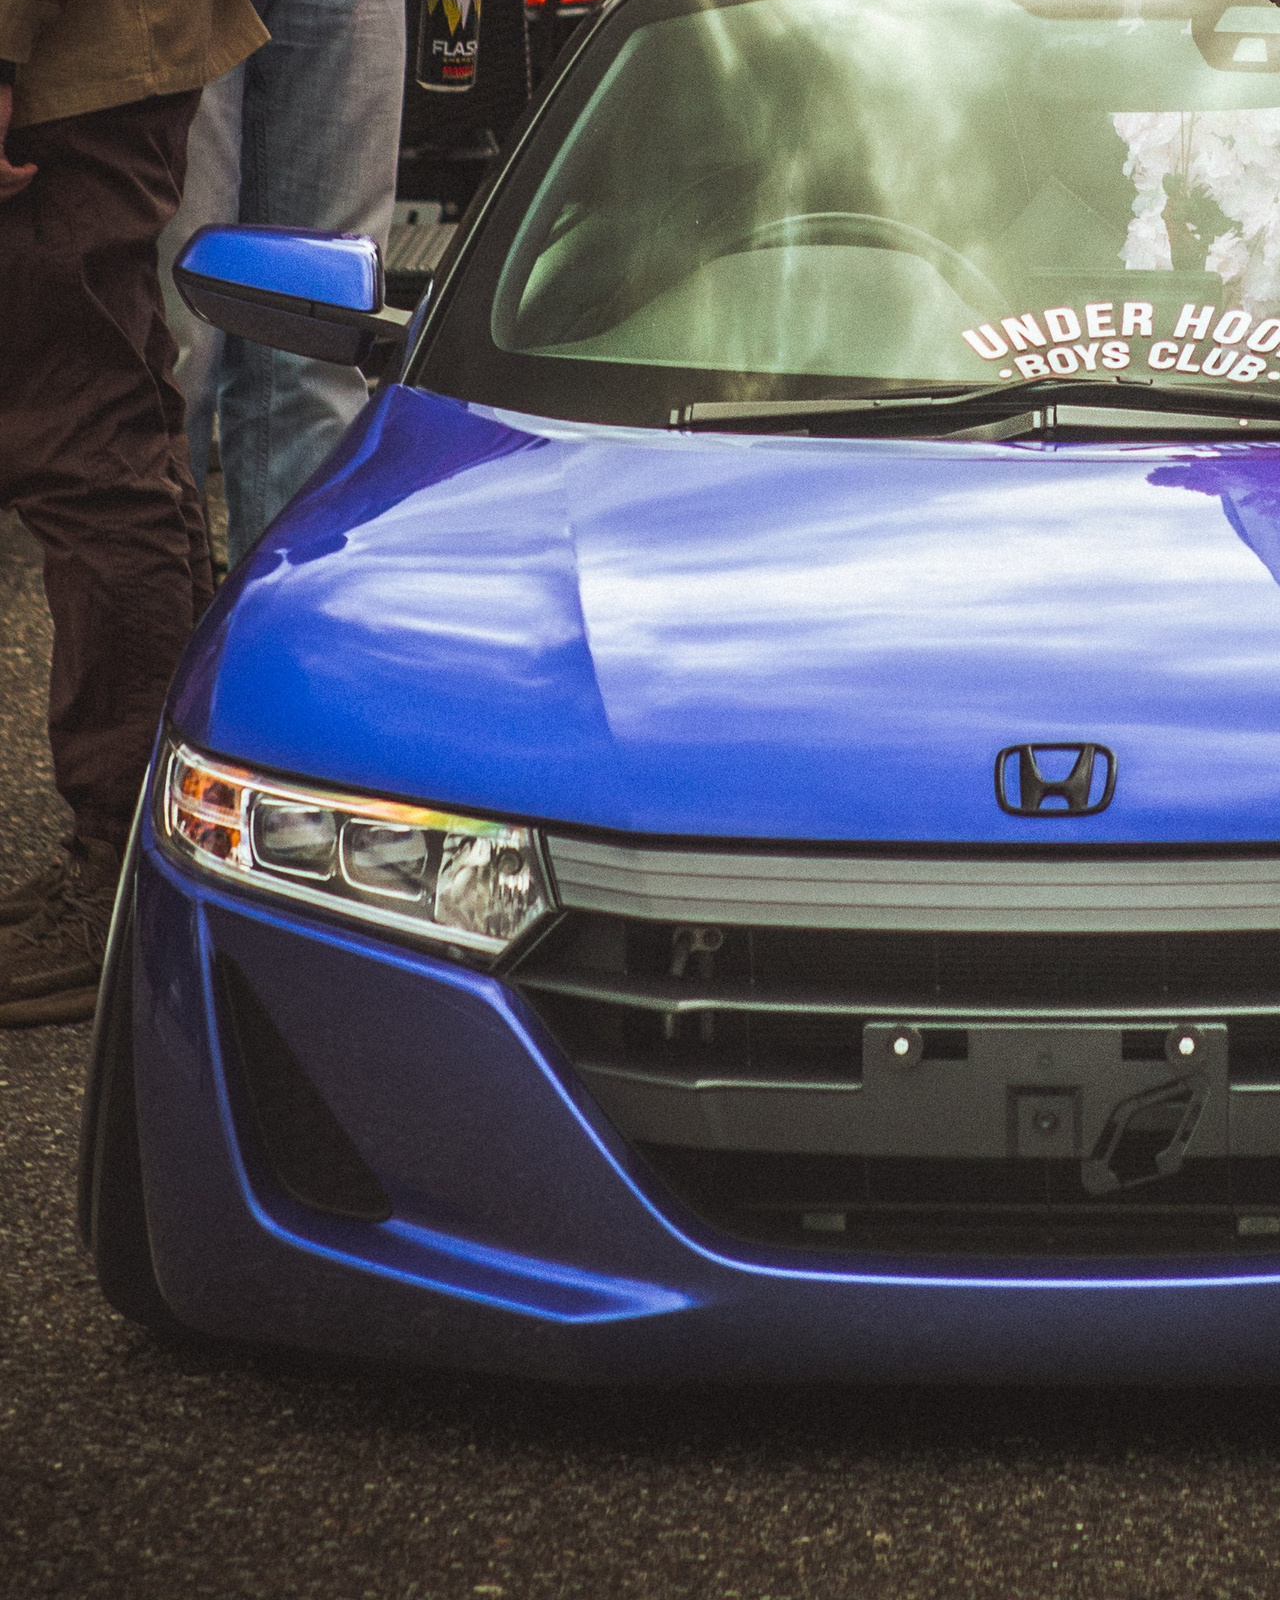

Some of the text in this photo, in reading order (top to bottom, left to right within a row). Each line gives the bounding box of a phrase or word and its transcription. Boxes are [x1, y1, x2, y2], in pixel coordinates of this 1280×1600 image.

[432, 39, 478, 57] FLAS
[962, 301, 1154, 360] UNDER
[1013, 340, 1268, 382] BOYS CLUB
